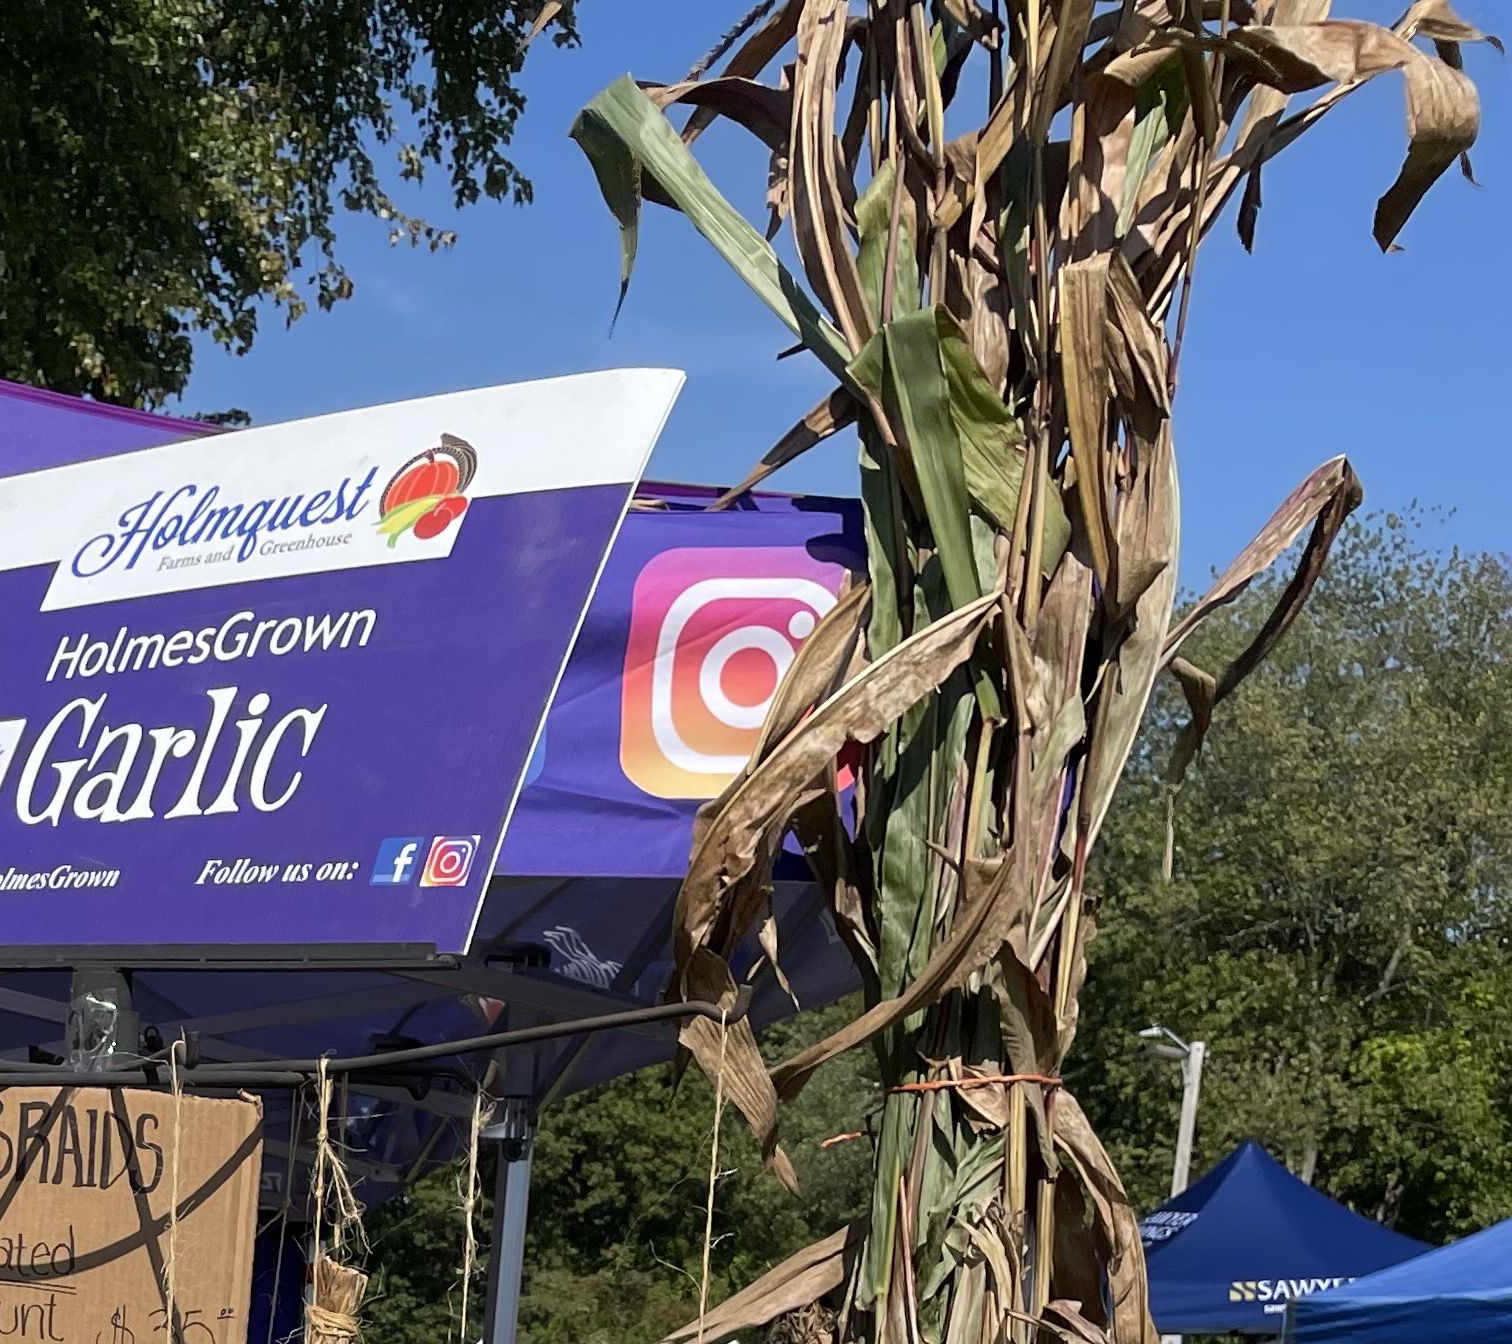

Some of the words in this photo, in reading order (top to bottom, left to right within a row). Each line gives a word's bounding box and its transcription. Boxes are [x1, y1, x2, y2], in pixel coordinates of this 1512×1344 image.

[72, 466, 379, 578] Holmquest
[156, 555, 202, 572] Farms
[204, 545, 236, 565] and
[259, 532, 353, 557] Greenhouse
[46, 607, 377, 682] HolmesGrown
[16, 686, 328, 827] Garlic
[194, 858, 279, 885] Follow
[282, 862, 313, 883] us
[316, 860, 359, 881] on:
